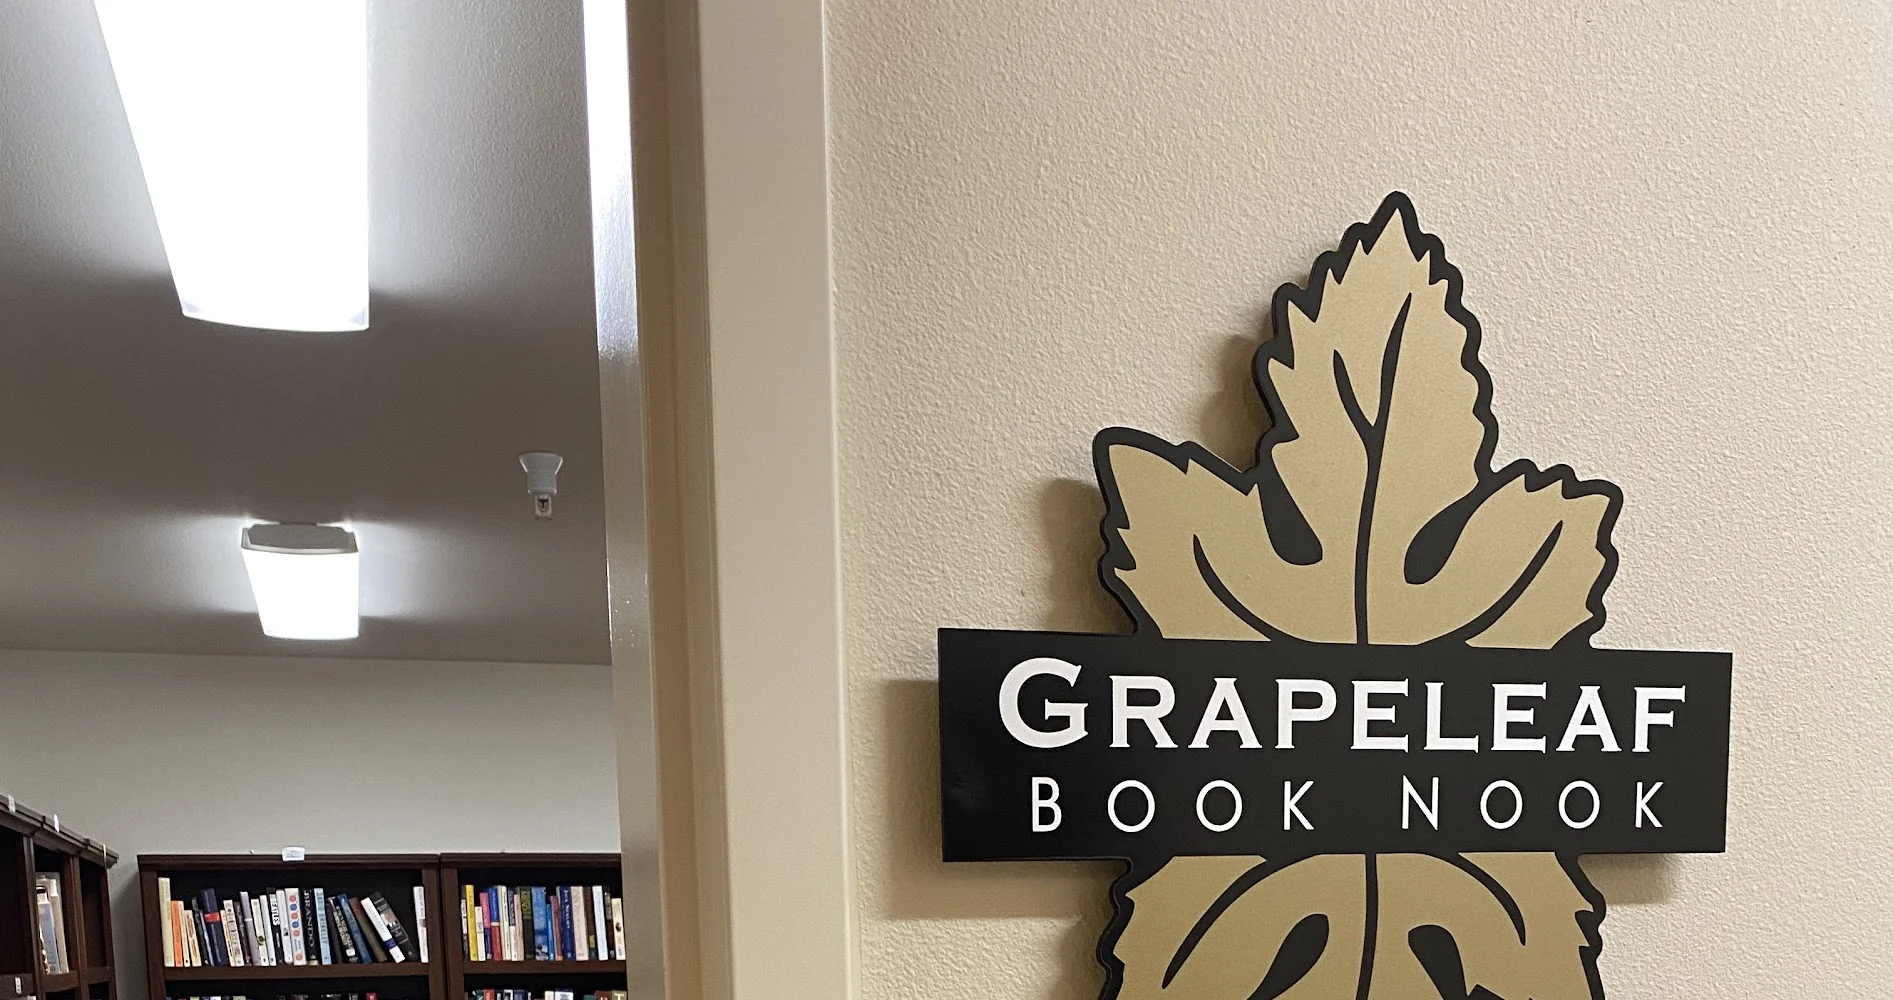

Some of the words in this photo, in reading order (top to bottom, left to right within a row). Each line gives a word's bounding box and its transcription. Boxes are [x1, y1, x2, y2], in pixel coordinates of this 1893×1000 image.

[998, 656, 1687, 753] GRAPELEAF
[1031, 776, 1315, 833] BOOK
[1401, 774, 1664, 829] NOOK
[270, 898, 280, 926] BEATLES
[304, 894, 315, 947] BRANDO
